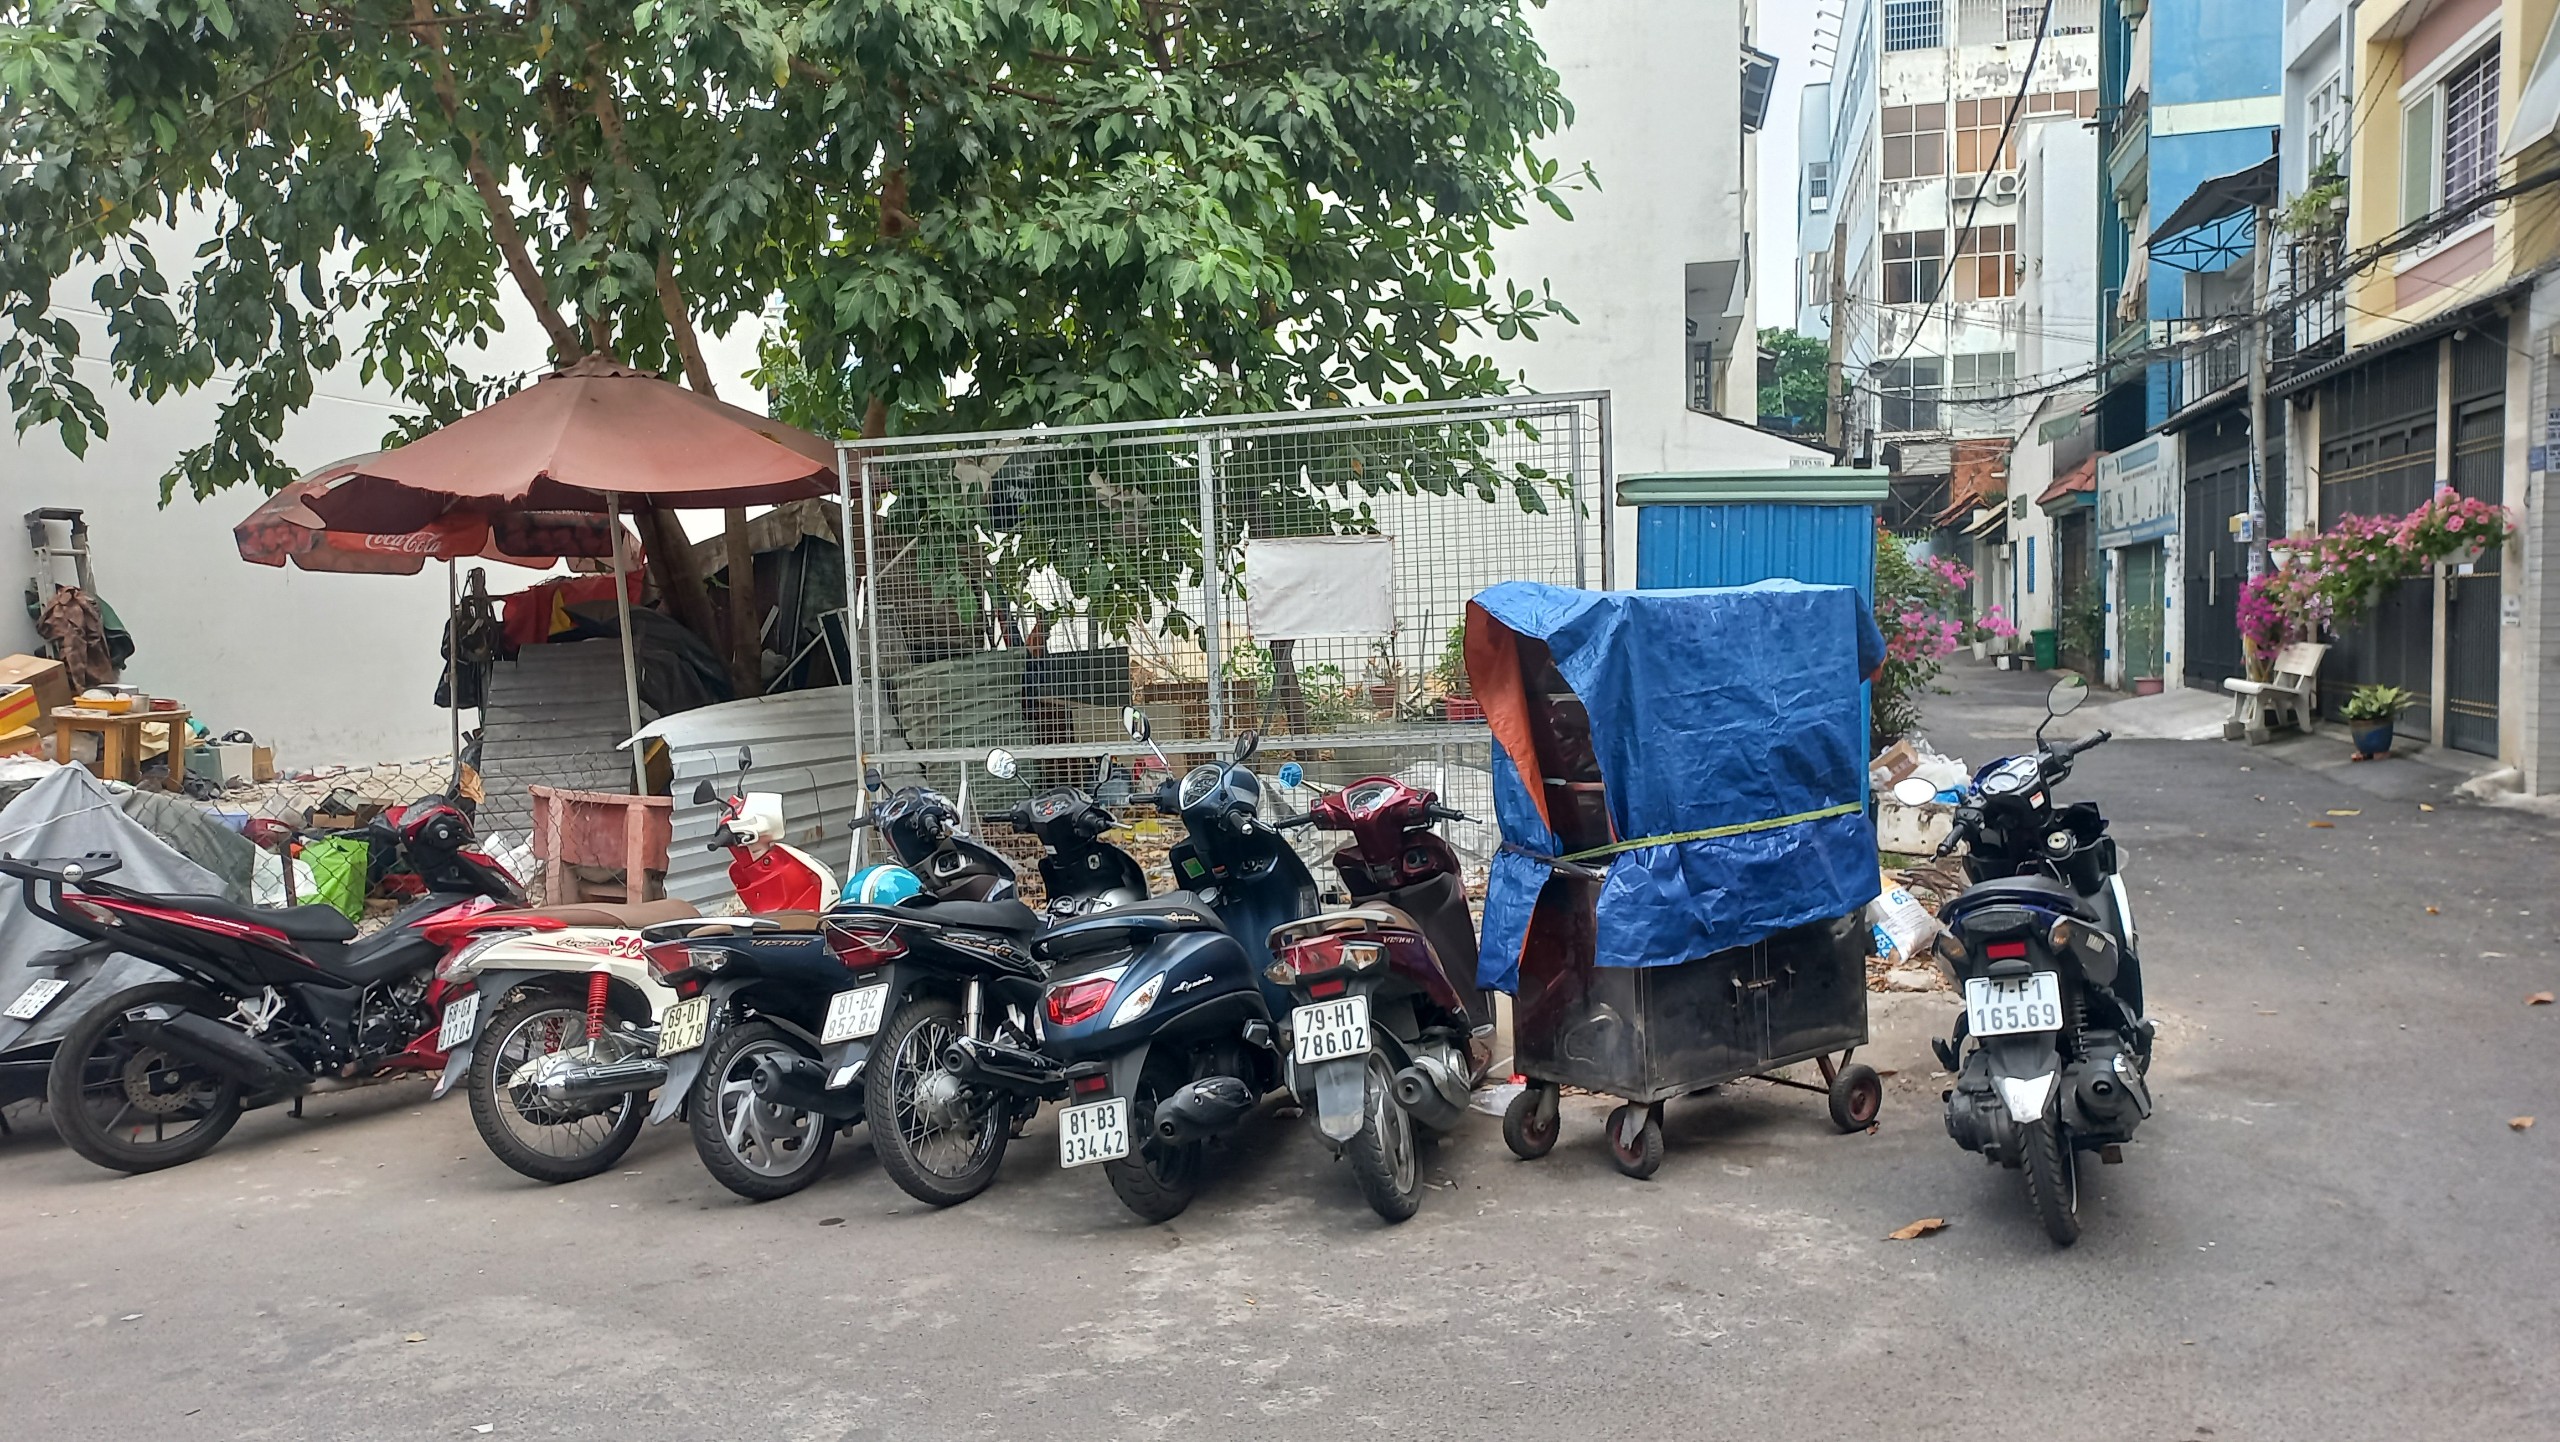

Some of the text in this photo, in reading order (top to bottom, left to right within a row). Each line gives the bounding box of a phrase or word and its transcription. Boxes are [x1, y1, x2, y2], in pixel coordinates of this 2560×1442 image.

[365, 532, 442, 553] Coca-Cola
[838, 989, 878, 1015] 81-B2
[1981, 978, 2042, 1004] 77-F1
[827, 1010, 877, 1039] 852.84
[1304, 1002, 1354, 1034] 79-H1
[1977, 1002, 2056, 1032] 165.69
[660, 1022, 703, 1053] 504.78
[1300, 1026, 1366, 1060] 786.02
[1070, 1105, 1115, 1136] 81-B3
[1065, 1130, 1124, 1163] 334.42
